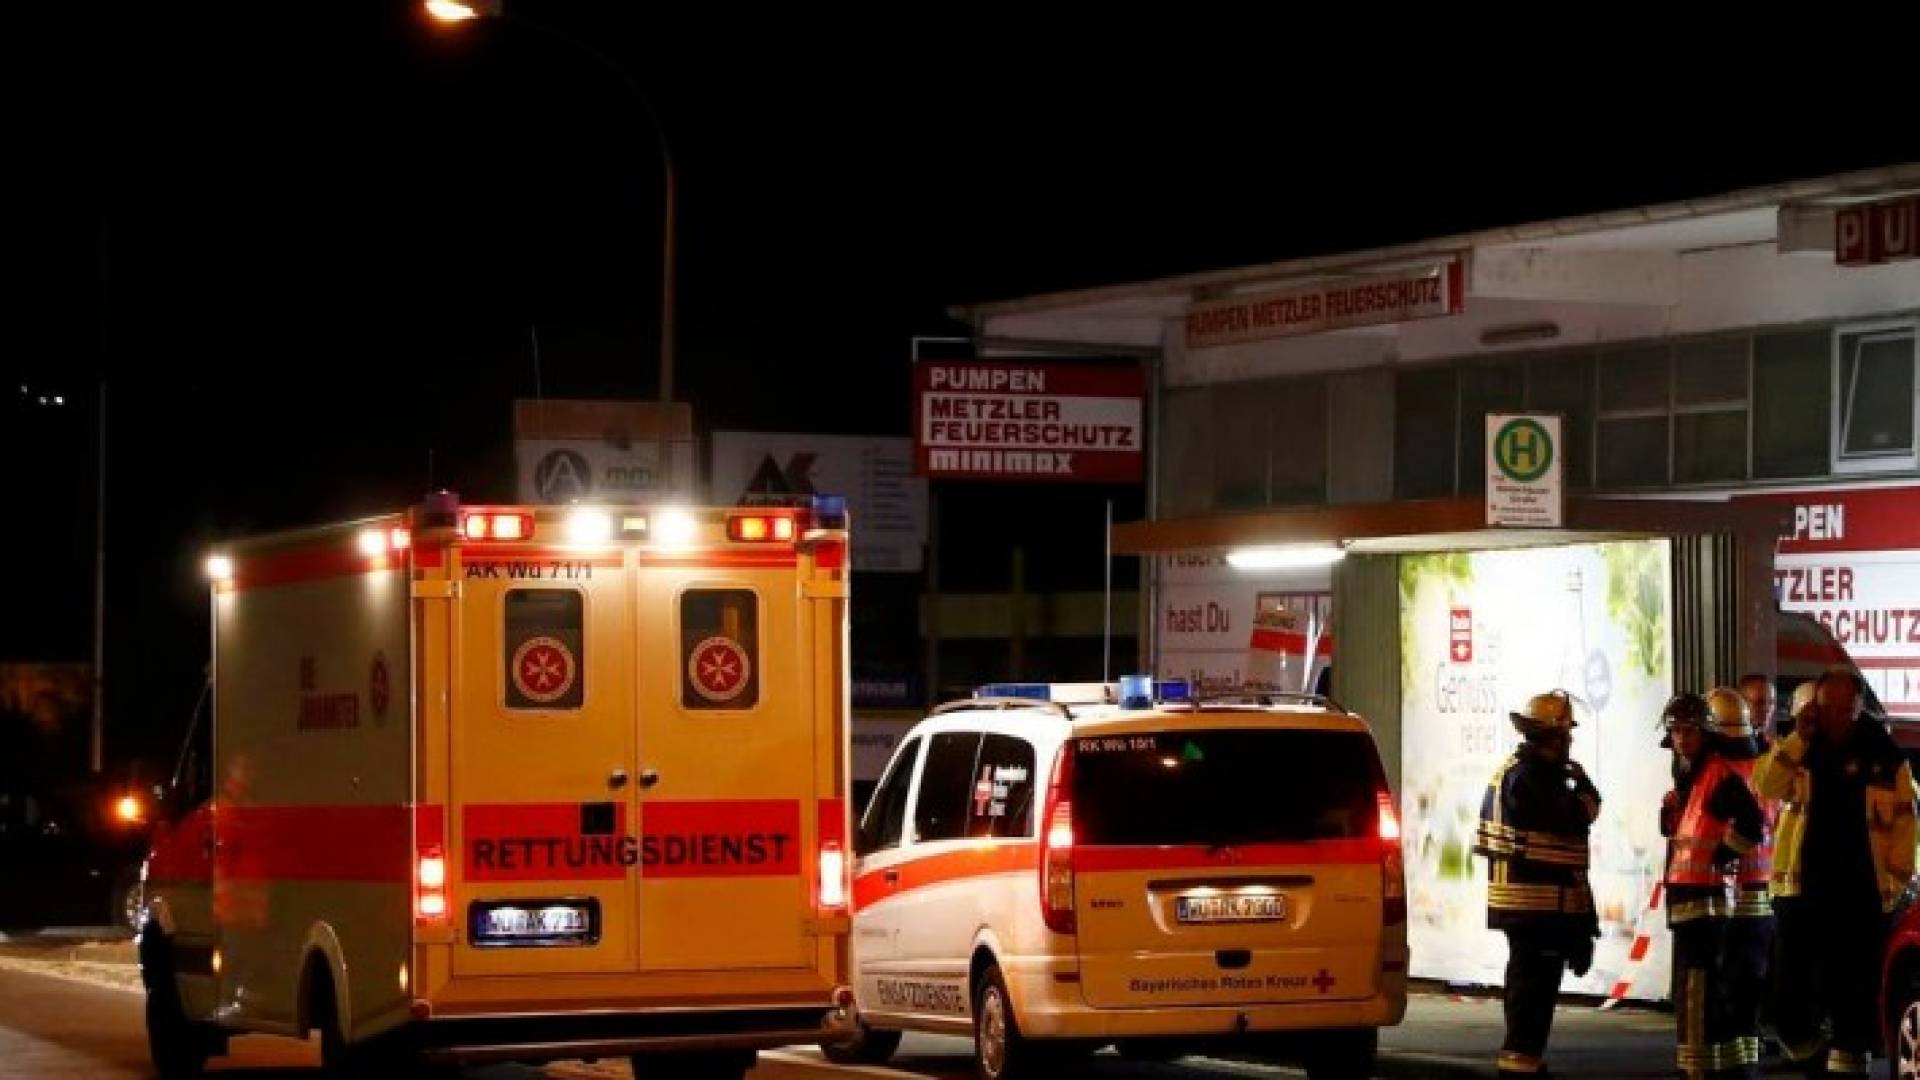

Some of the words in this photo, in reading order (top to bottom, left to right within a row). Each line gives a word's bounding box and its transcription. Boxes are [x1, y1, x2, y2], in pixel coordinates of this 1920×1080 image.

[1186, 303, 1249, 337] PUMPEN
[1252, 294, 1321, 326] METZLER
[1326, 278, 1440, 317] FEUERSCHUTZ
[929, 366, 1046, 392] PUMPEN
[929, 397, 1061, 421] METZLER
[929, 421, 1134, 447] FEUERSCHUTZ
[1508, 431, 1538, 466] H
[929, 450, 1073, 474] minimax
[1794, 503, 1845, 540] PEN
[467, 561, 498, 579] AK
[550, 560, 592, 579] 71/1
[1206, 601, 1230, 632] Du
[472, 833, 790, 870] RETTUNGSDIENST
[1129, 977, 1219, 994] Bayerisches
[1221, 976, 1262, 990] Rotes
[1266, 974, 1308, 987] Kreuz
